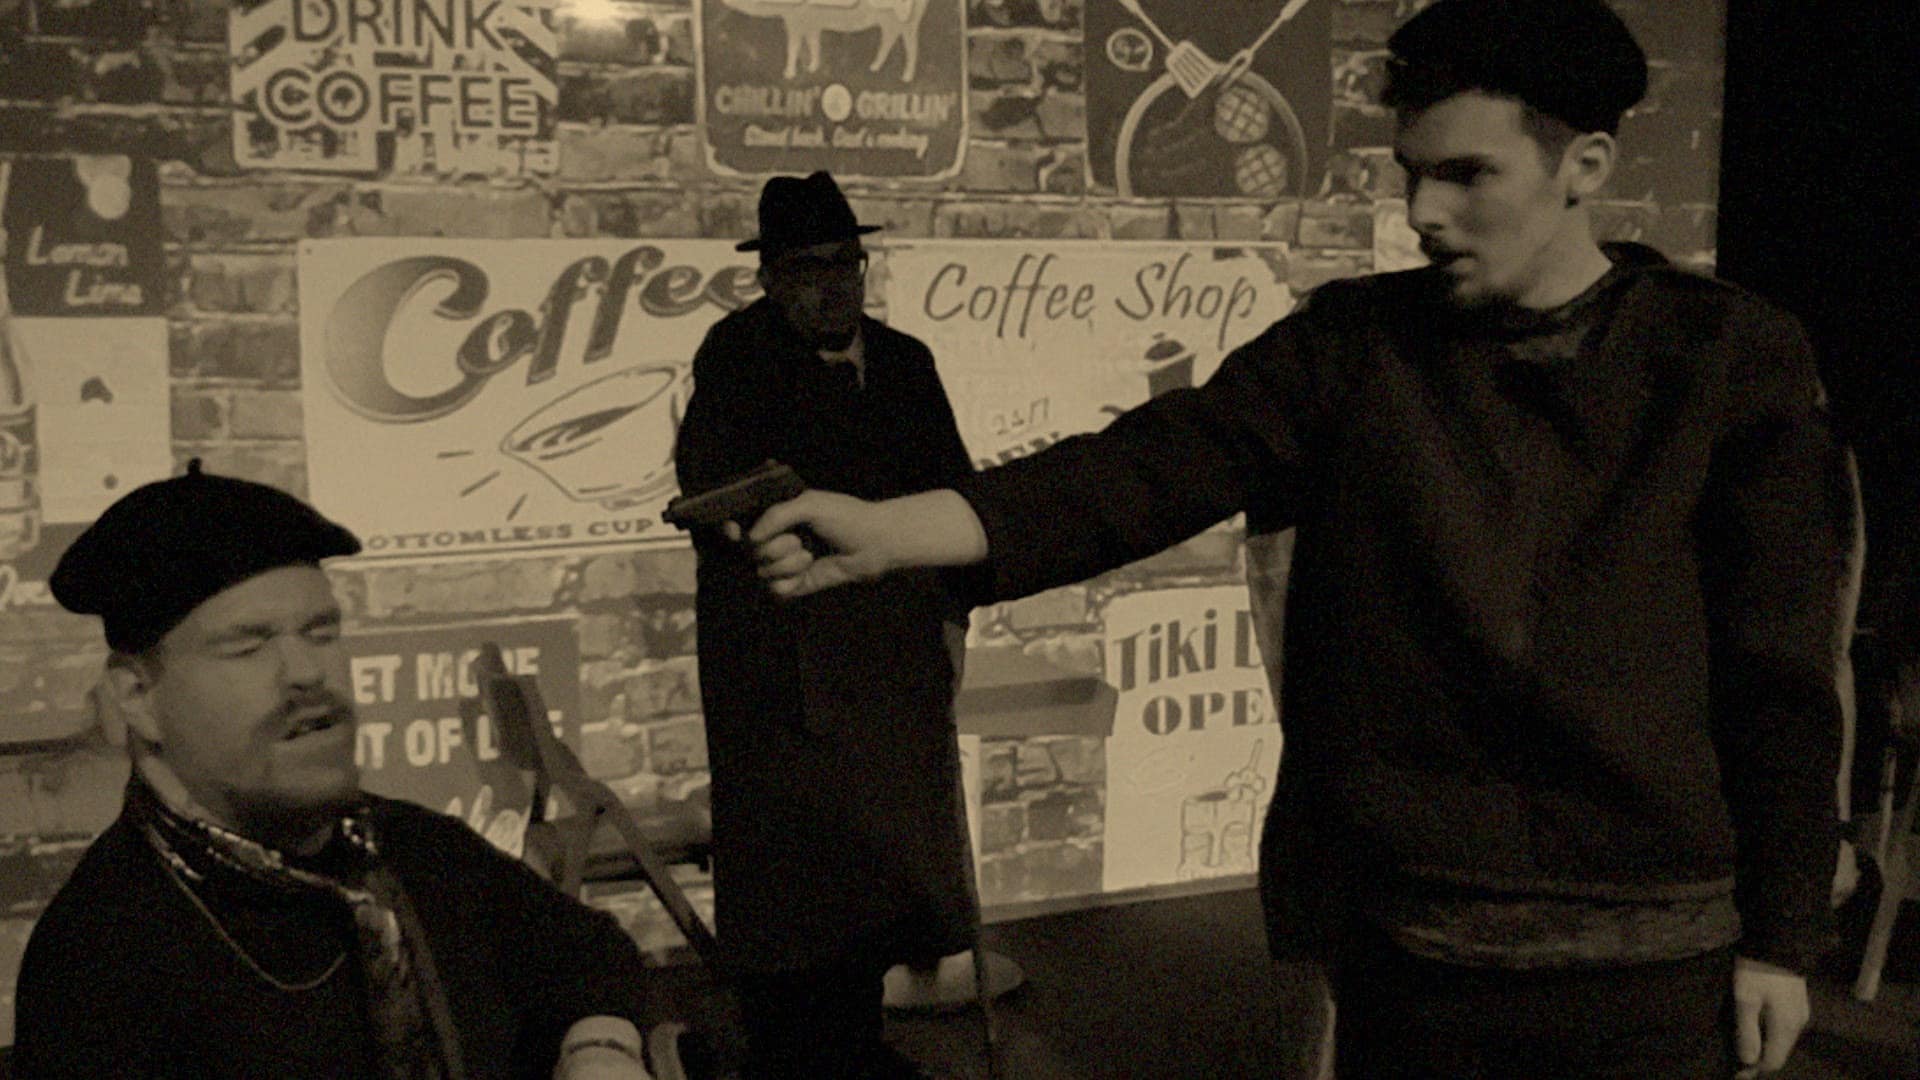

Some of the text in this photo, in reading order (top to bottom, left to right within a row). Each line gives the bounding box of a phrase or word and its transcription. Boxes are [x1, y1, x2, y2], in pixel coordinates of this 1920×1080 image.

[293, 0, 503, 50] DRINK
[264, 68, 533, 129] COFFEE
[924, 252, 1258, 352] Coffee Shop
[322, 245, 763, 425] Coffee
[367, 523, 573, 550] OTTOMLESS
[1112, 609, 1218, 693] Tiki
[350, 653, 402, 704] ET
[1142, 687, 1280, 735] OPE
[405, 718, 463, 767] OF
